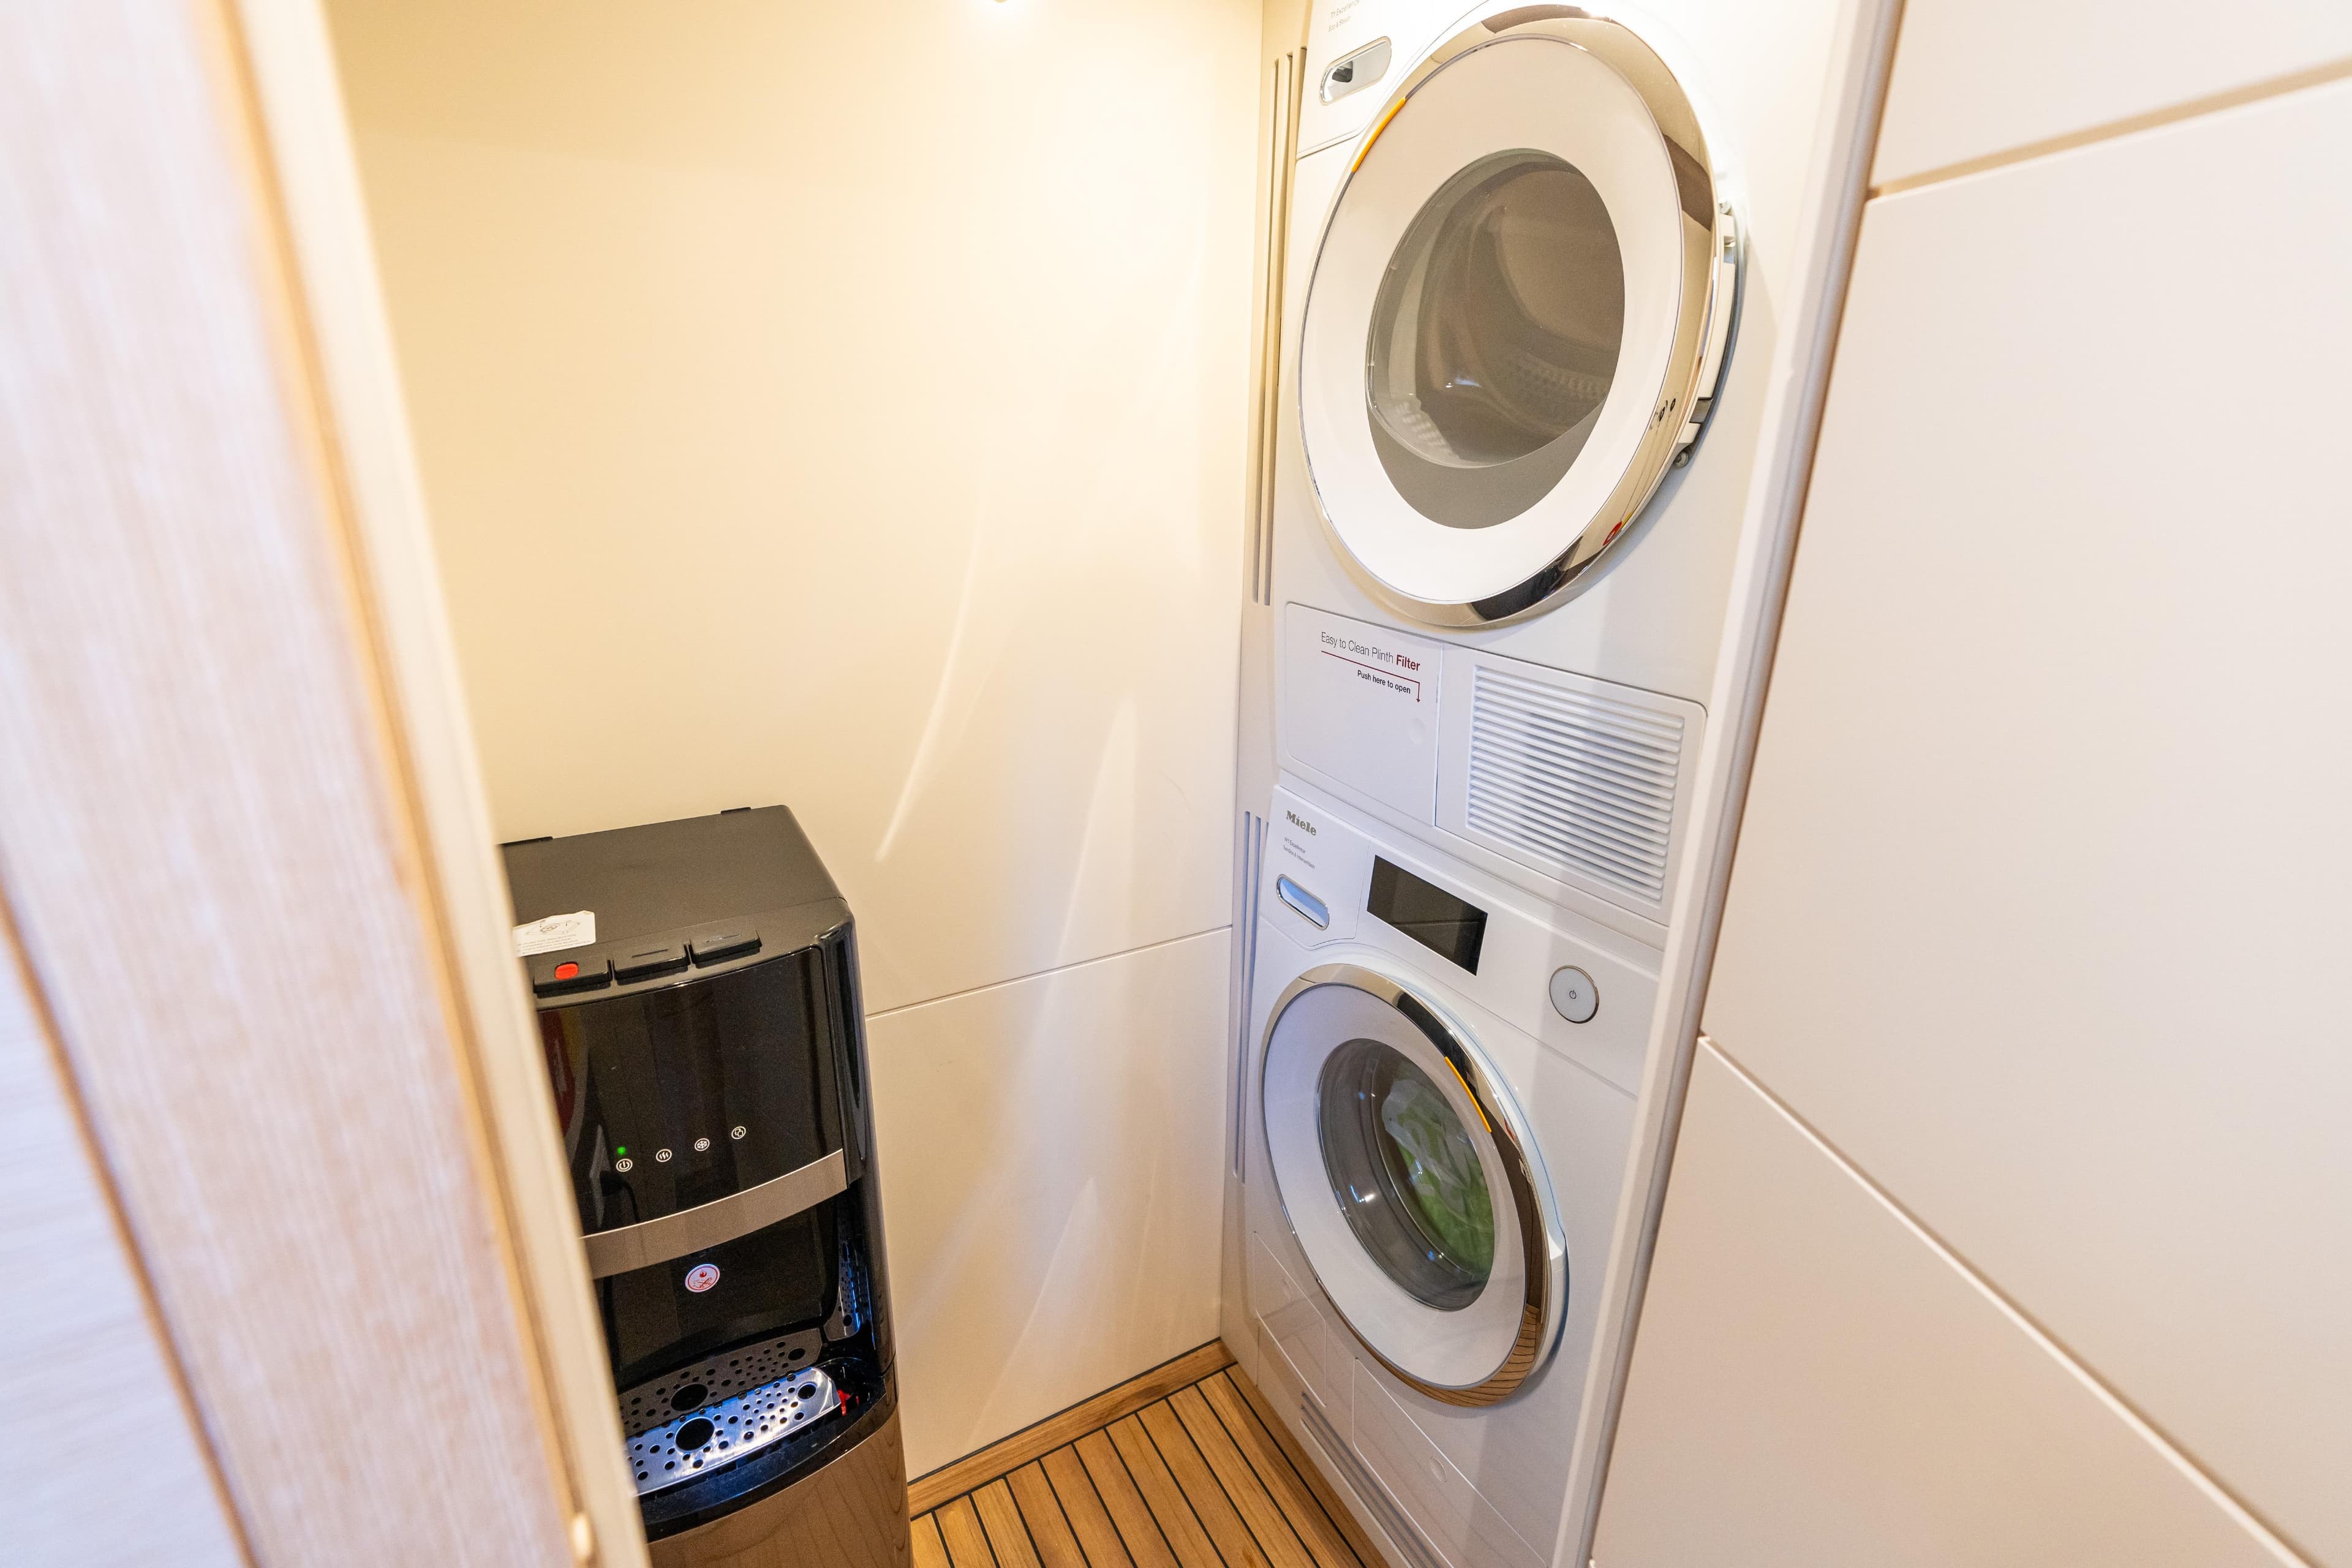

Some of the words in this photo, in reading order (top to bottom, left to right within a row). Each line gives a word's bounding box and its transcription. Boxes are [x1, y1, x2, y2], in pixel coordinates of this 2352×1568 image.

[1321, 631, 1338, 648] Easy
[1339, 638, 1346, 649] to
[1348, 640, 1370, 656] Clean
[1371, 647, 1393, 663] Plinth
[1396, 654, 1420, 671] Filter
[1357, 669, 1371, 681] Push
[1373, 674, 1385, 685] here
[1387, 680, 1393, 688] to
[1395, 684, 1411, 694] open
[1286, 810, 1317, 836] Miele
